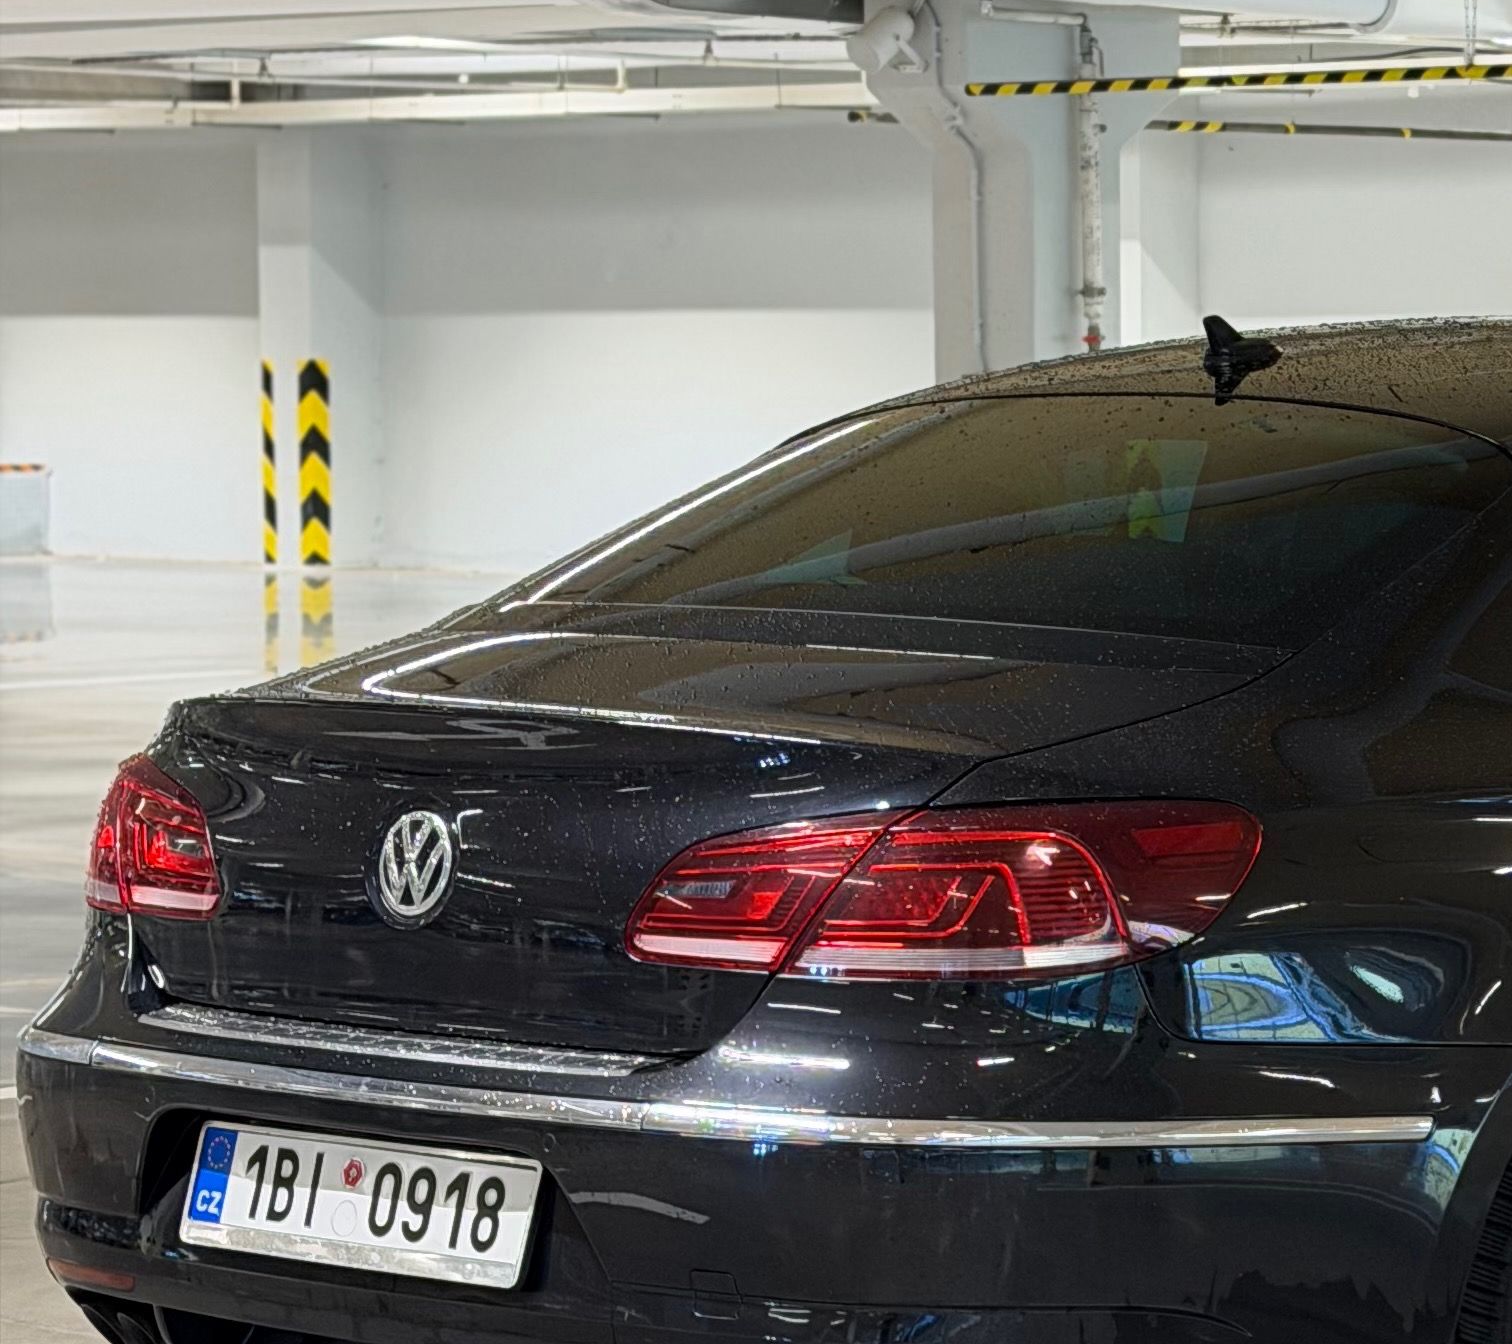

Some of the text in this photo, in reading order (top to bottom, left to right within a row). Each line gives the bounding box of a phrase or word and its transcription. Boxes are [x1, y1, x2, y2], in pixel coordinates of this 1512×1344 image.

[379, 810, 452, 916] VW
[196, 1189, 222, 1216] CZ
[245, 1144, 506, 1253] 1BI 0918
